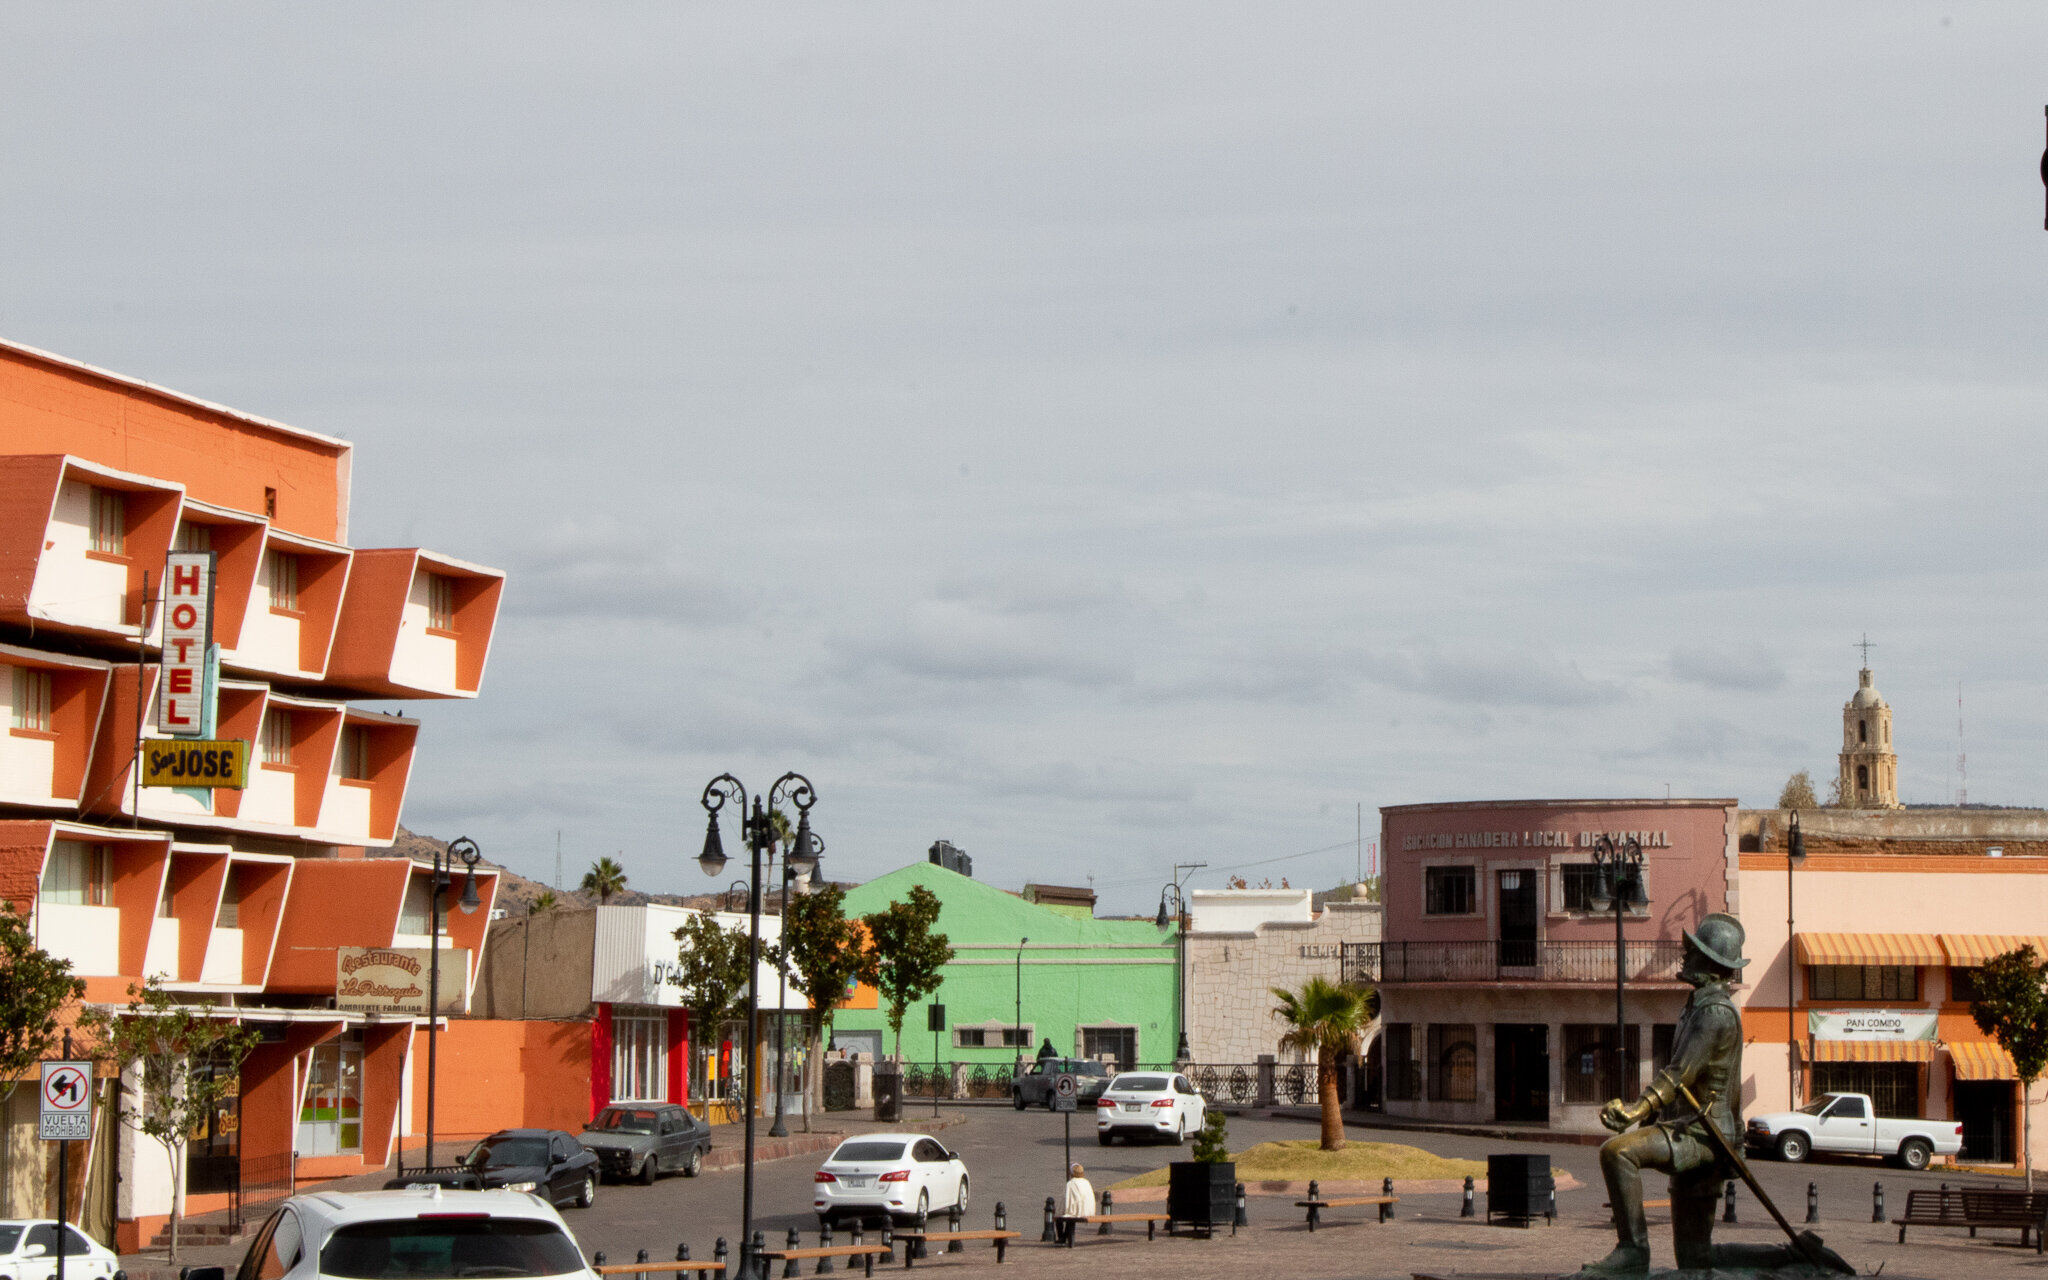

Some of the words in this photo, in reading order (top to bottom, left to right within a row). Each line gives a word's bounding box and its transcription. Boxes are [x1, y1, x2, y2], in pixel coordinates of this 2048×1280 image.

[168, 564, 201, 725] HOTEL
[150, 750, 177, 777] San
[172, 749, 234, 778] JOSE
[1454, 831, 1518, 849] GANADERA
[1523, 831, 1574, 848] LOCAL
[341, 950, 422, 976] Restaurante
[339, 977, 359, 996] La
[357, 980, 423, 1004] Parroquia
[339, 1004, 380, 1012] AMBIENTE
[383, 1004, 422, 1012] FAMILIAR
[1846, 1018, 1865, 1027] PAN
[1867, 1018, 1901, 1027] COMIDO
[45, 1115, 87, 1125] VUELTA
[44, 1125, 87, 1136] PROHIBIDA
